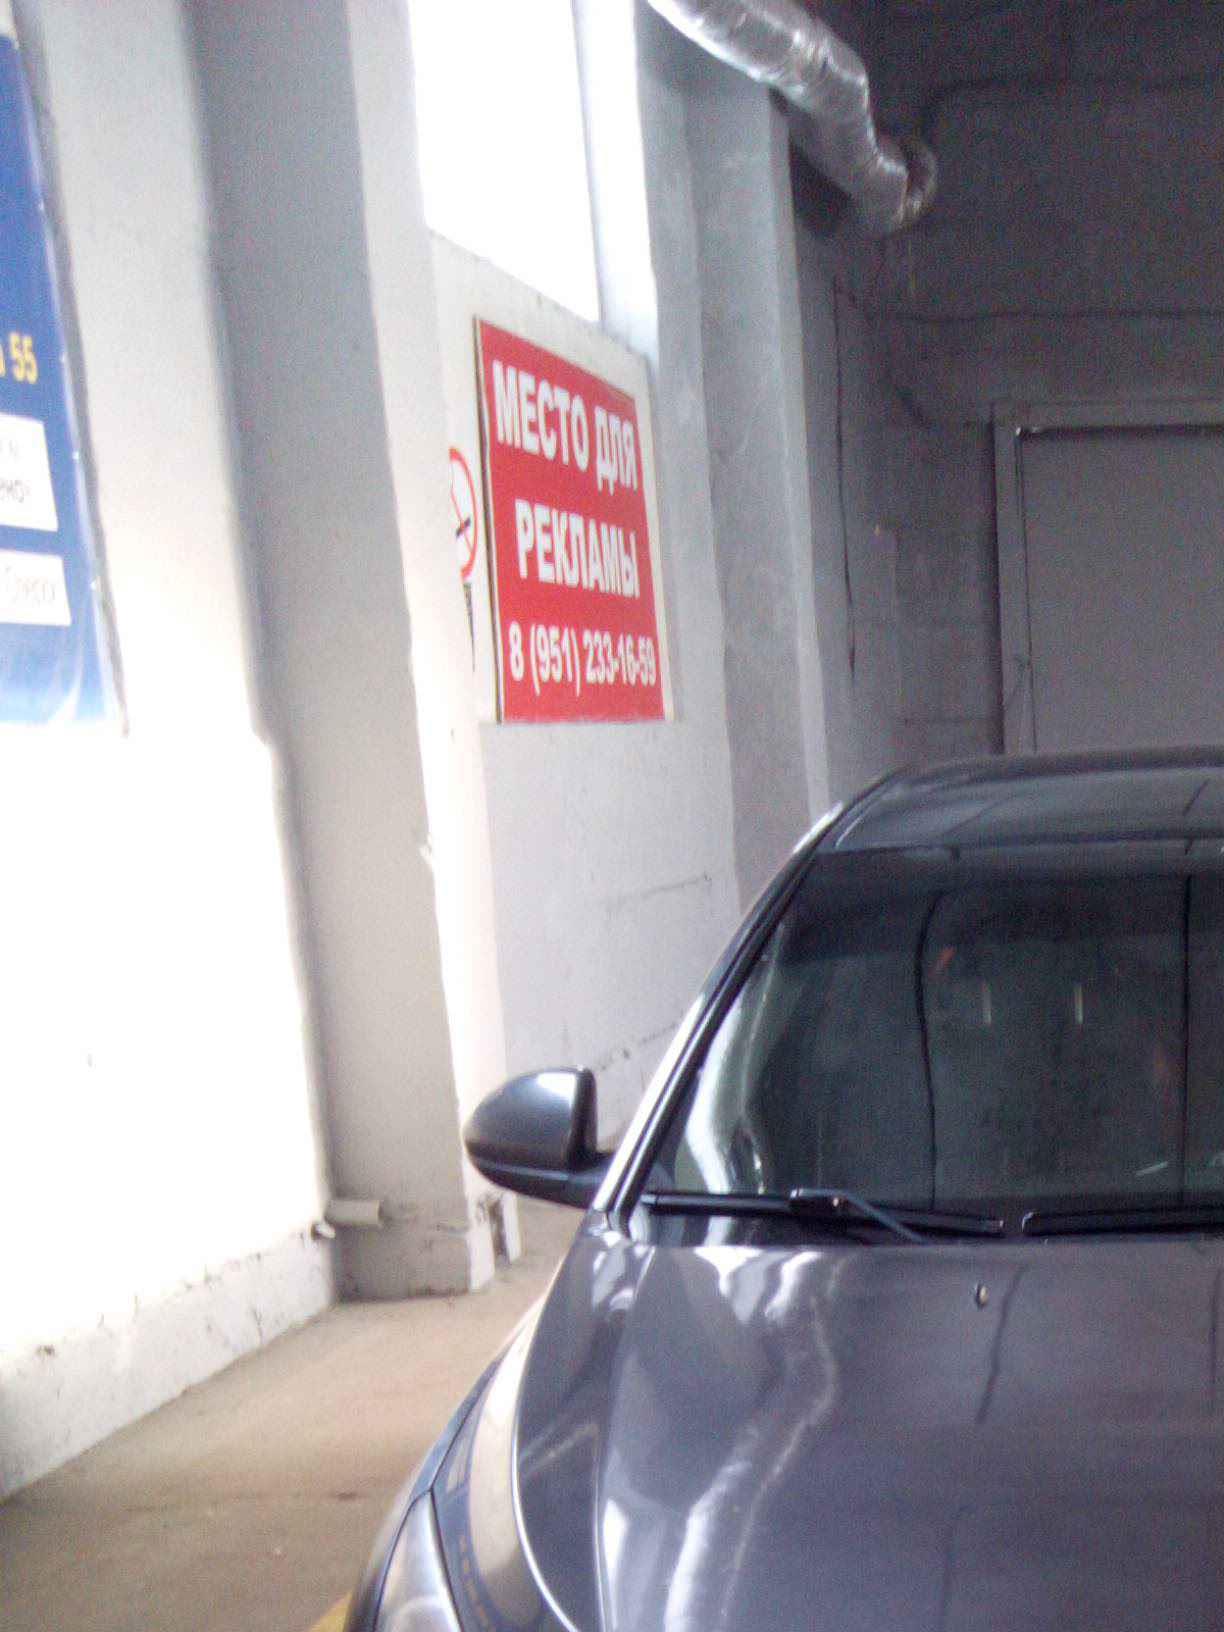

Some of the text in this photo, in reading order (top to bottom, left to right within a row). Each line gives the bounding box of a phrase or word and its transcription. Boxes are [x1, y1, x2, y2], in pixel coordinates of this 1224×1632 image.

[492, 359, 637, 496] МЕСТО ДЛЯ
[515, 499, 640, 599] РЕКЛАМЫ
[509, 621, 656, 697] 8 (951) 233-16-59
